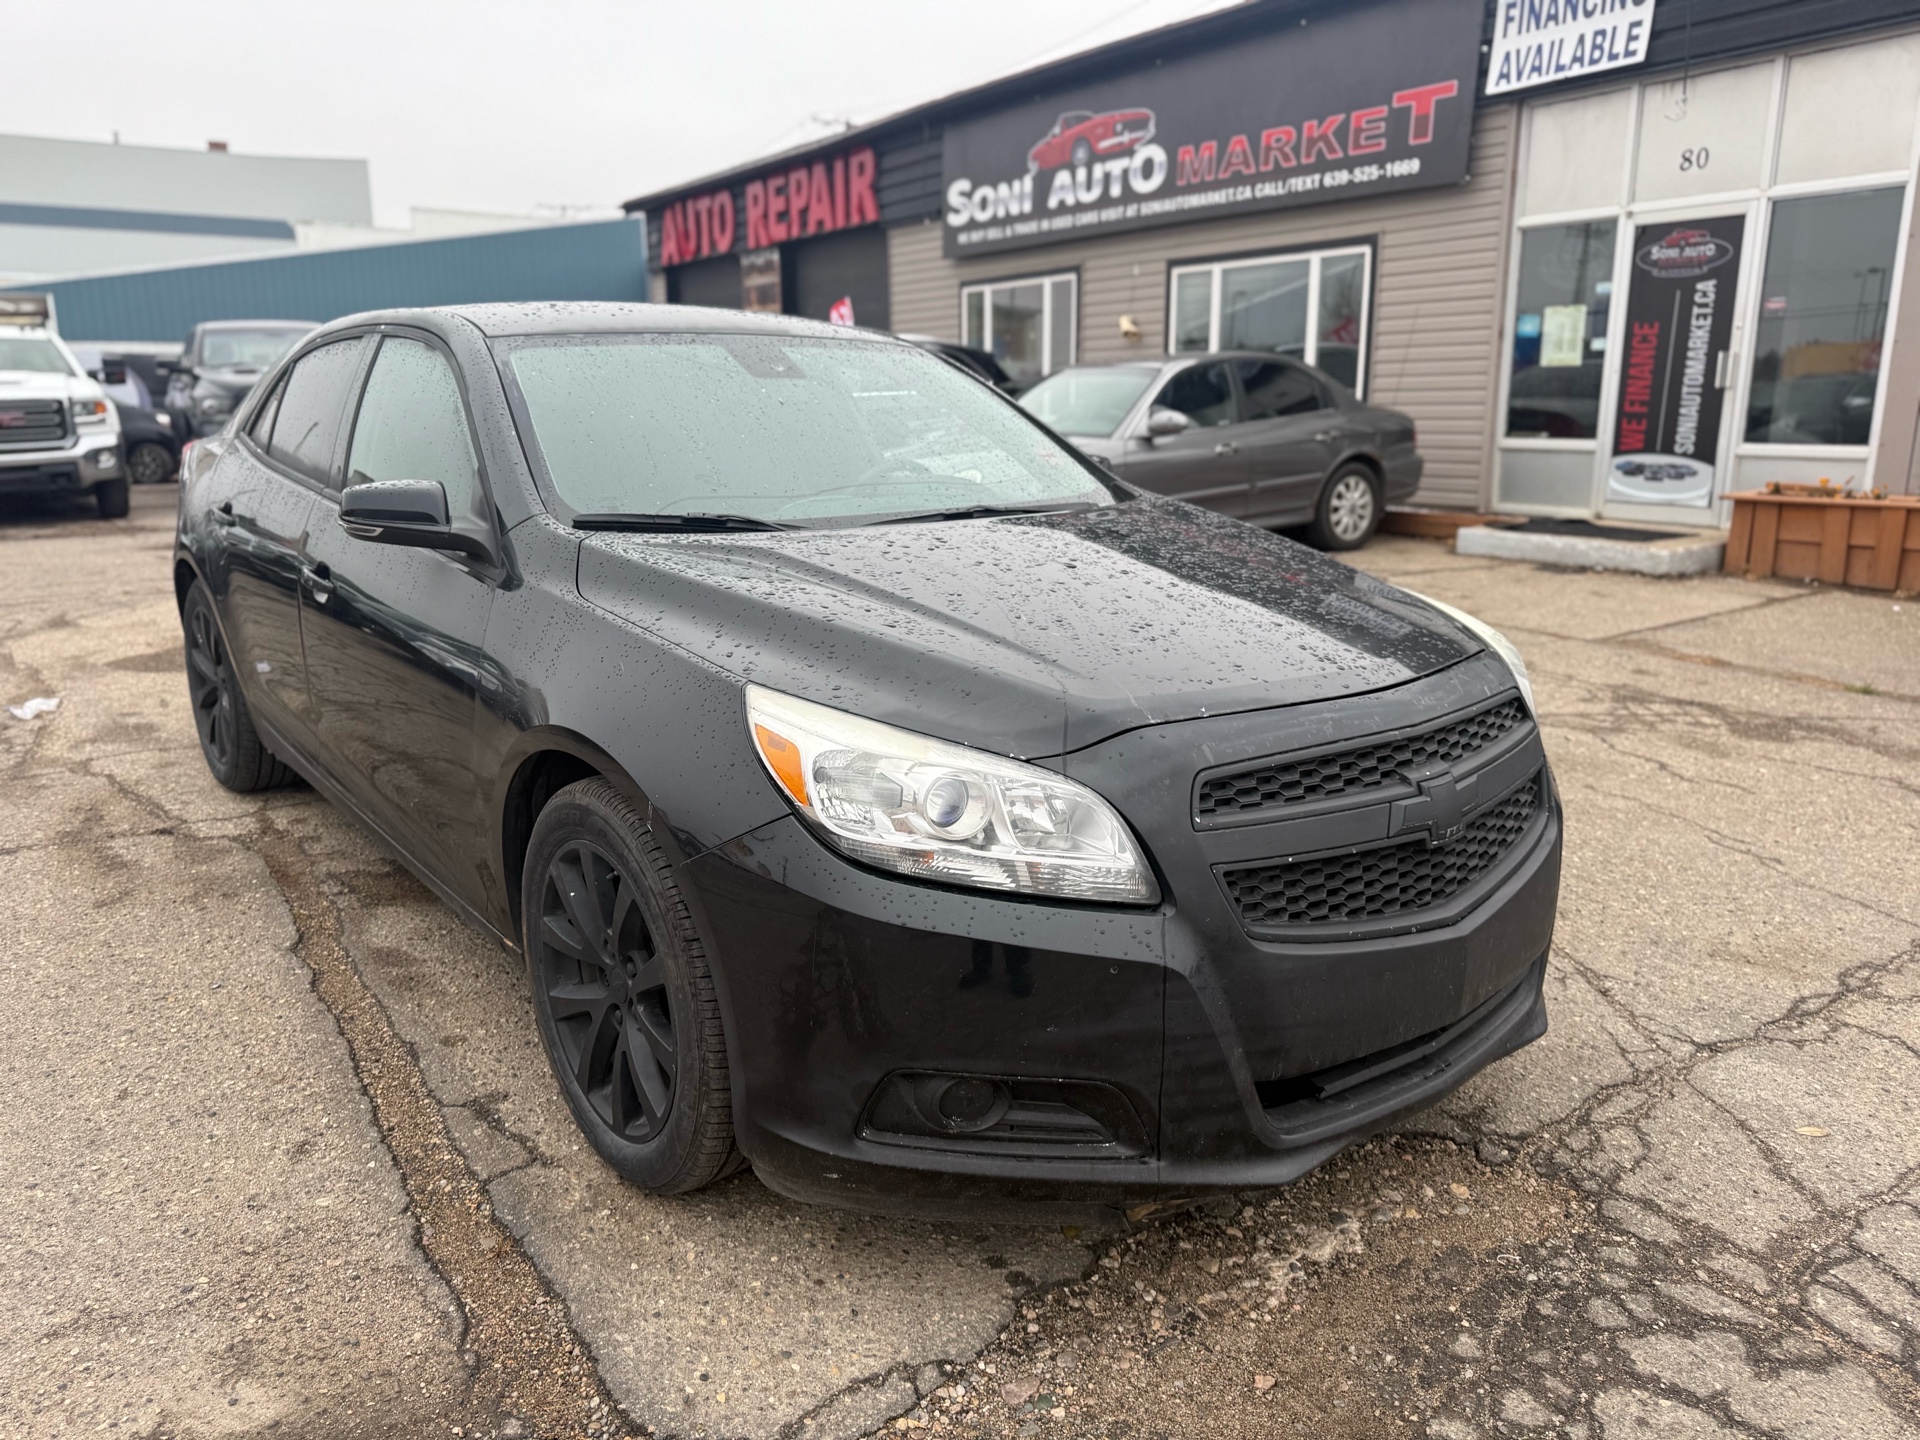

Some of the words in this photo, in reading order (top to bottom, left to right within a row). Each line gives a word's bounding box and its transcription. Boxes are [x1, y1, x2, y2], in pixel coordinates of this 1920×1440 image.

[1503, 0, 1648, 38] FINANC
[1495, 20, 1643, 87] AVAILABLE
[946, 174, 1032, 227] SONI
[1047, 143, 1168, 210] AUTO
[1176, 80, 1458, 185] MARKET
[1679, 147, 1710, 172] 80
[661, 189, 735, 267] AUTO
[745, 146, 880, 250] REPAIR
[1051, 214, 1074, 231] USED
[1075, 209, 1099, 228] CARS
[1101, 205, 1125, 223] VISIT
[1125, 203, 1139, 219] AT
[1255, 173, 1322, 199] CALL/TEXT
[1682, 243, 1716, 257] AUTO
[1624, 321, 1660, 414] FINANCE
[1674, 279, 1718, 455] SONIAUTOMARKET.CA
[1619, 417, 1648, 451] WE
